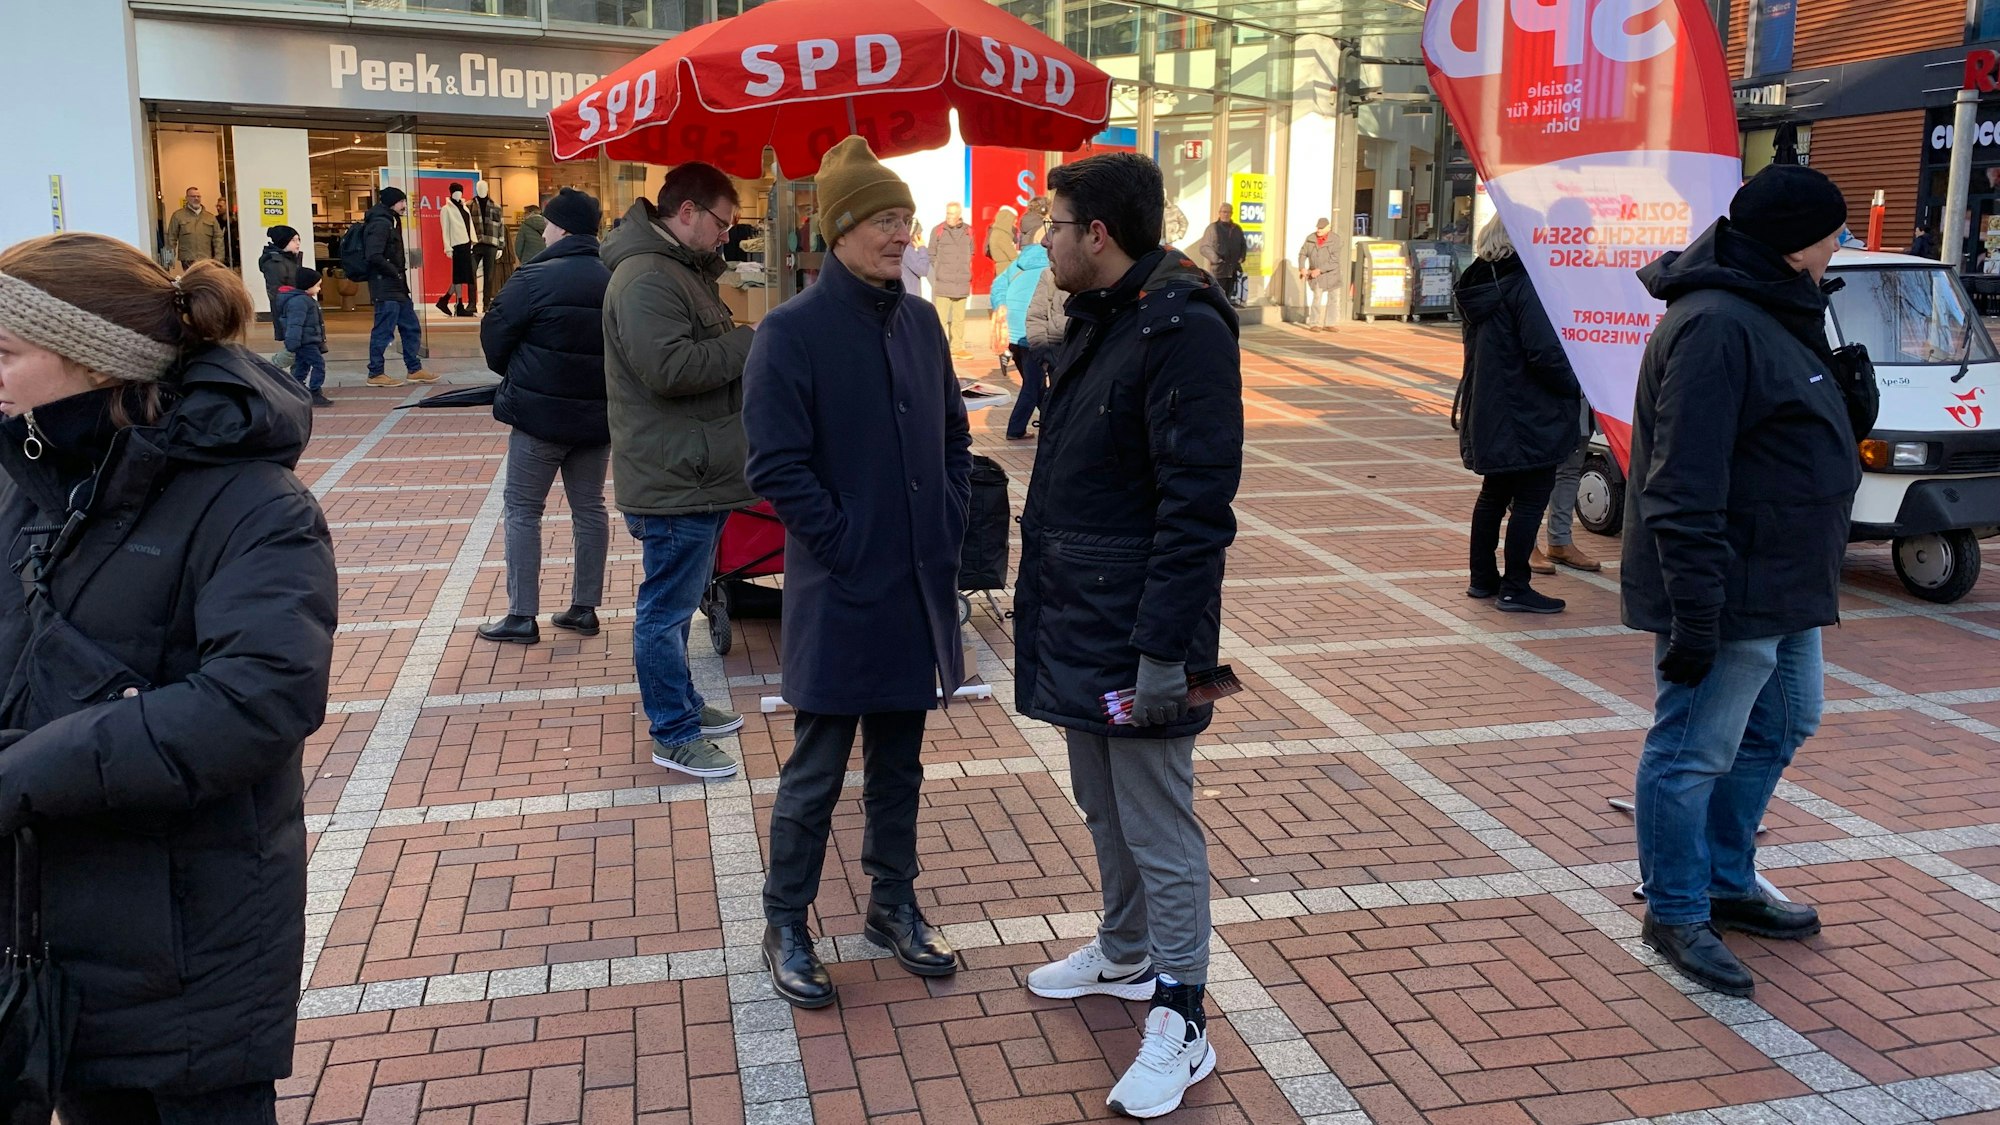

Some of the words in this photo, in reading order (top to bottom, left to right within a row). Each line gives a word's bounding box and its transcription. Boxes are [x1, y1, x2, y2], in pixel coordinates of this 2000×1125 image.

[329, 44, 608, 109] Peek&Cloppe
[741, 33, 902, 98] SPD
[981, 36, 1076, 106] SPD
[1964, 49, 2000, 92] R
[578, 69, 657, 142] SPD
[1240, 179, 1252, 190] ON
[1240, 205, 1265, 221] 30%
[1244, 233, 1264, 249] 0%
